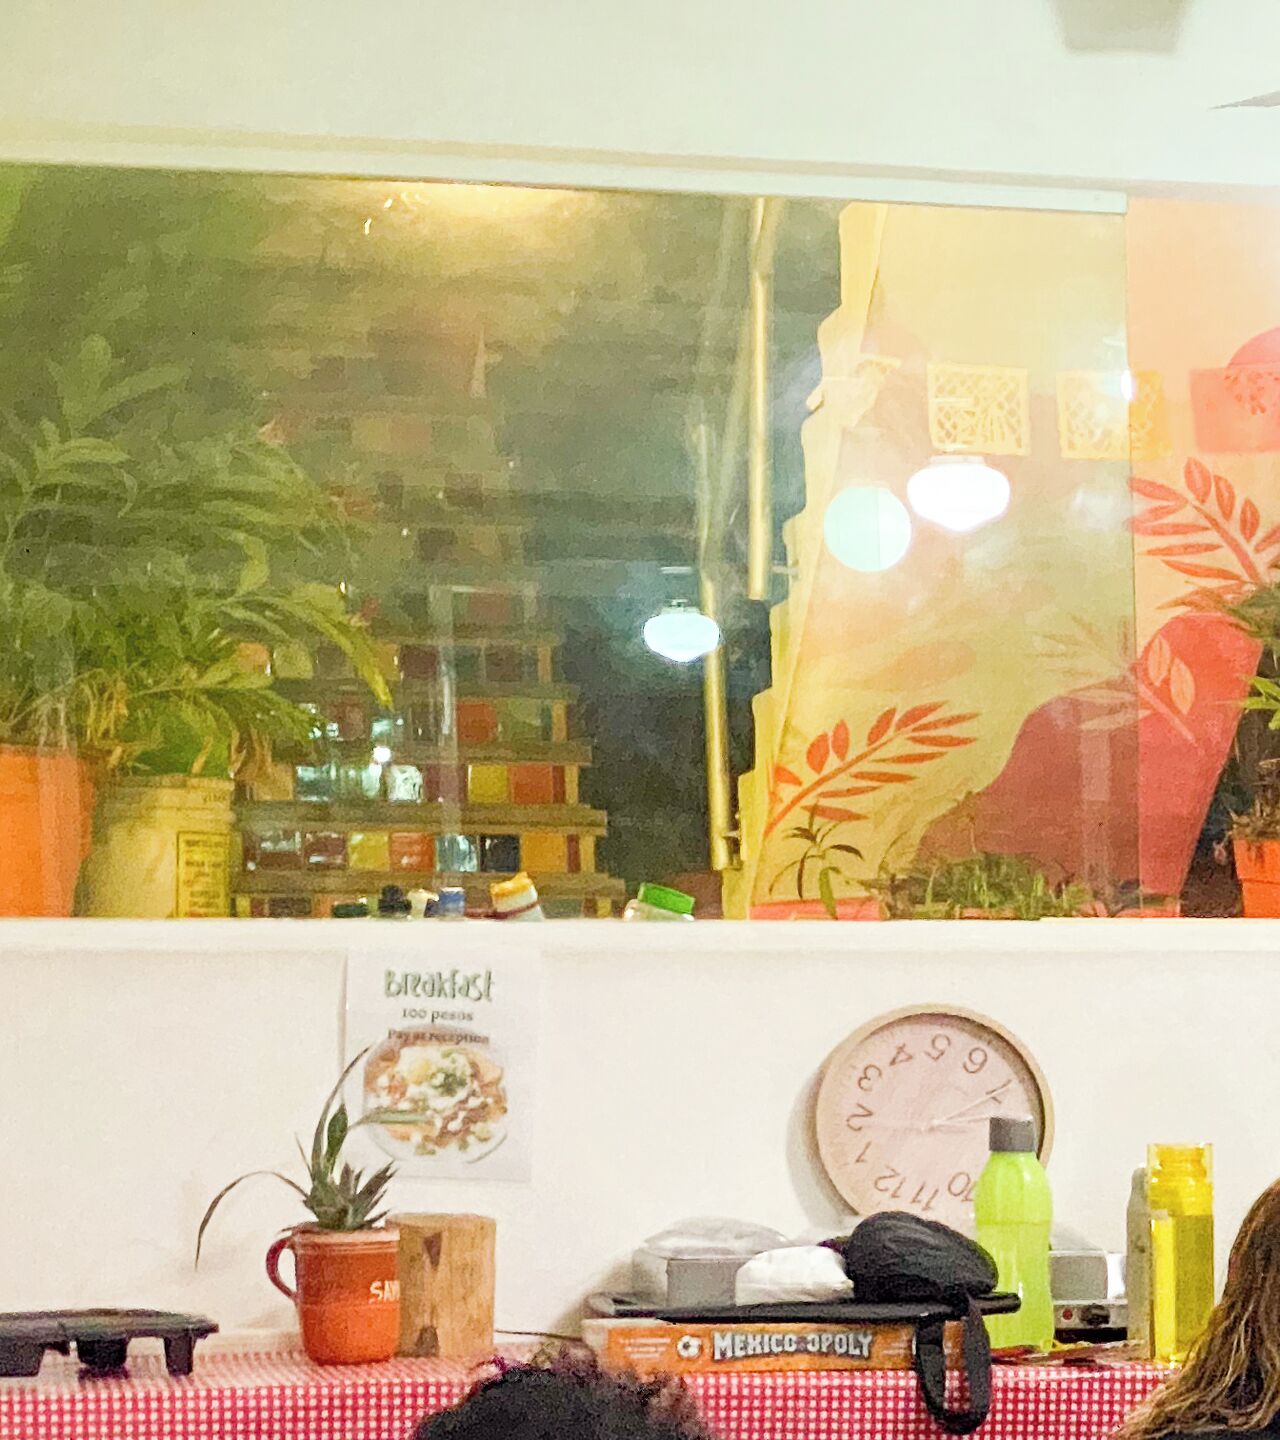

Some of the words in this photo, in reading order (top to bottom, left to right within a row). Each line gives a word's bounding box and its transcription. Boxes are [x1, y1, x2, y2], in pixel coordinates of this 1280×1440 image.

[384, 967, 493, 1002] Breakfast
[402, 1008, 427, 1019] 100
[430, 1010, 473, 1024] pesos
[889, 1043, 914, 1067] 4
[925, 1033, 952, 1061] 5
[963, 1047, 988, 1074] 6
[857, 1064, 882, 1092] 3
[846, 1102, 874, 1132] 2
[855, 1141, 873, 1164] 1
[873, 1163, 906, 1199] 12
[909, 1180, 940, 1212] 11
